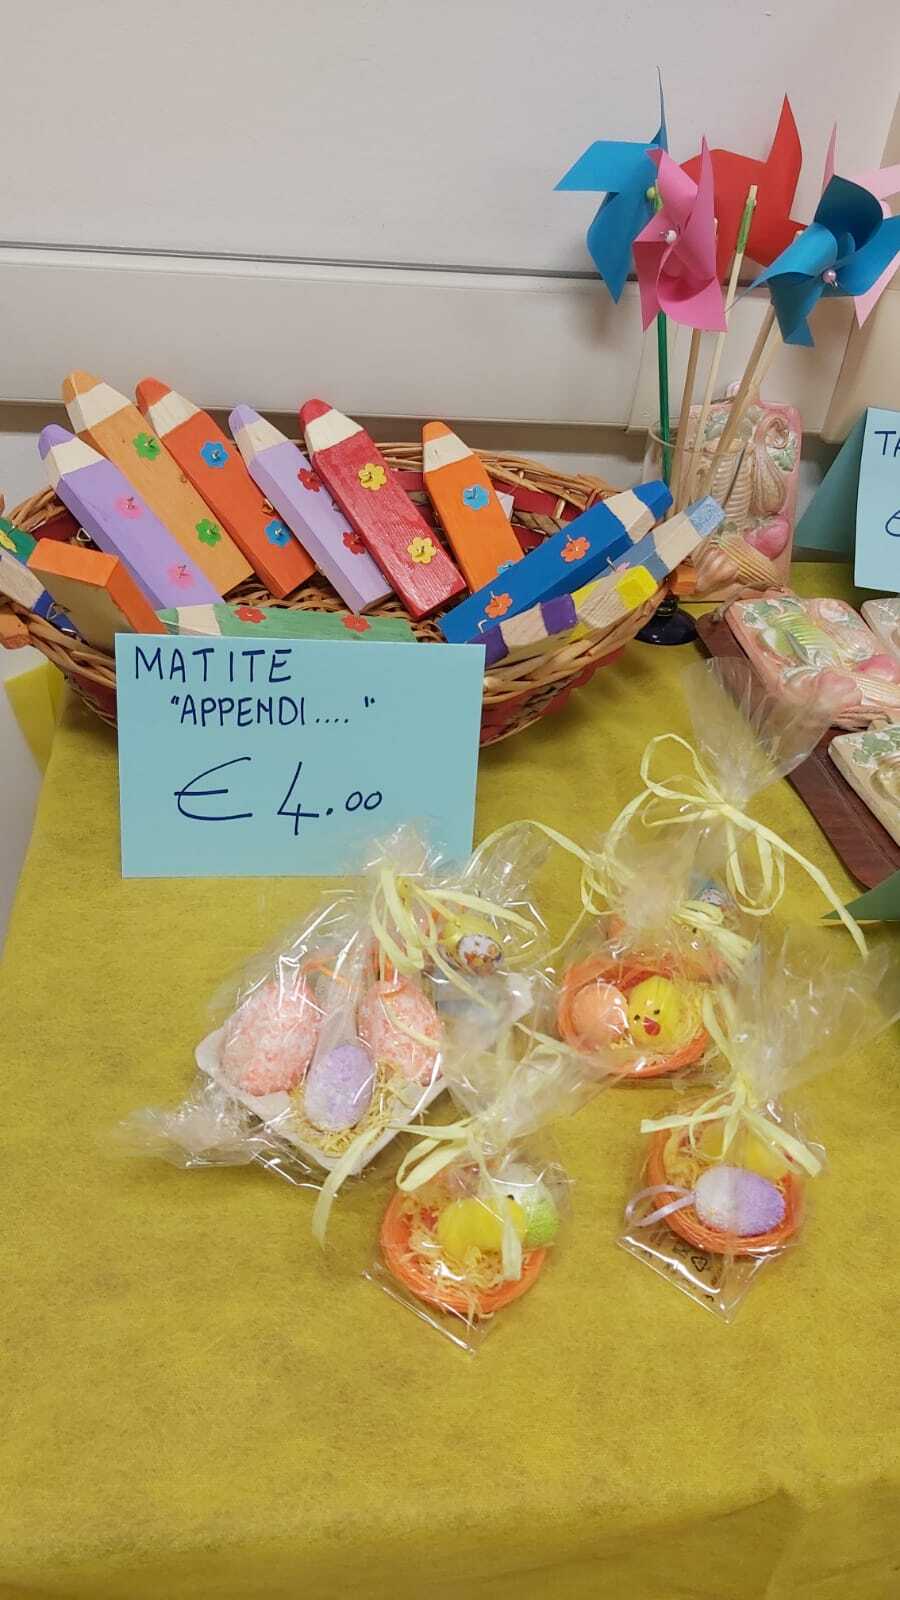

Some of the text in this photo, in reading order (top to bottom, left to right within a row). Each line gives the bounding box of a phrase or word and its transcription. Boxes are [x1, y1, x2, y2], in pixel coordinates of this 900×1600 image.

[134, 645, 293, 683] MATITE
[173, 756, 384, 837] € 4.00
